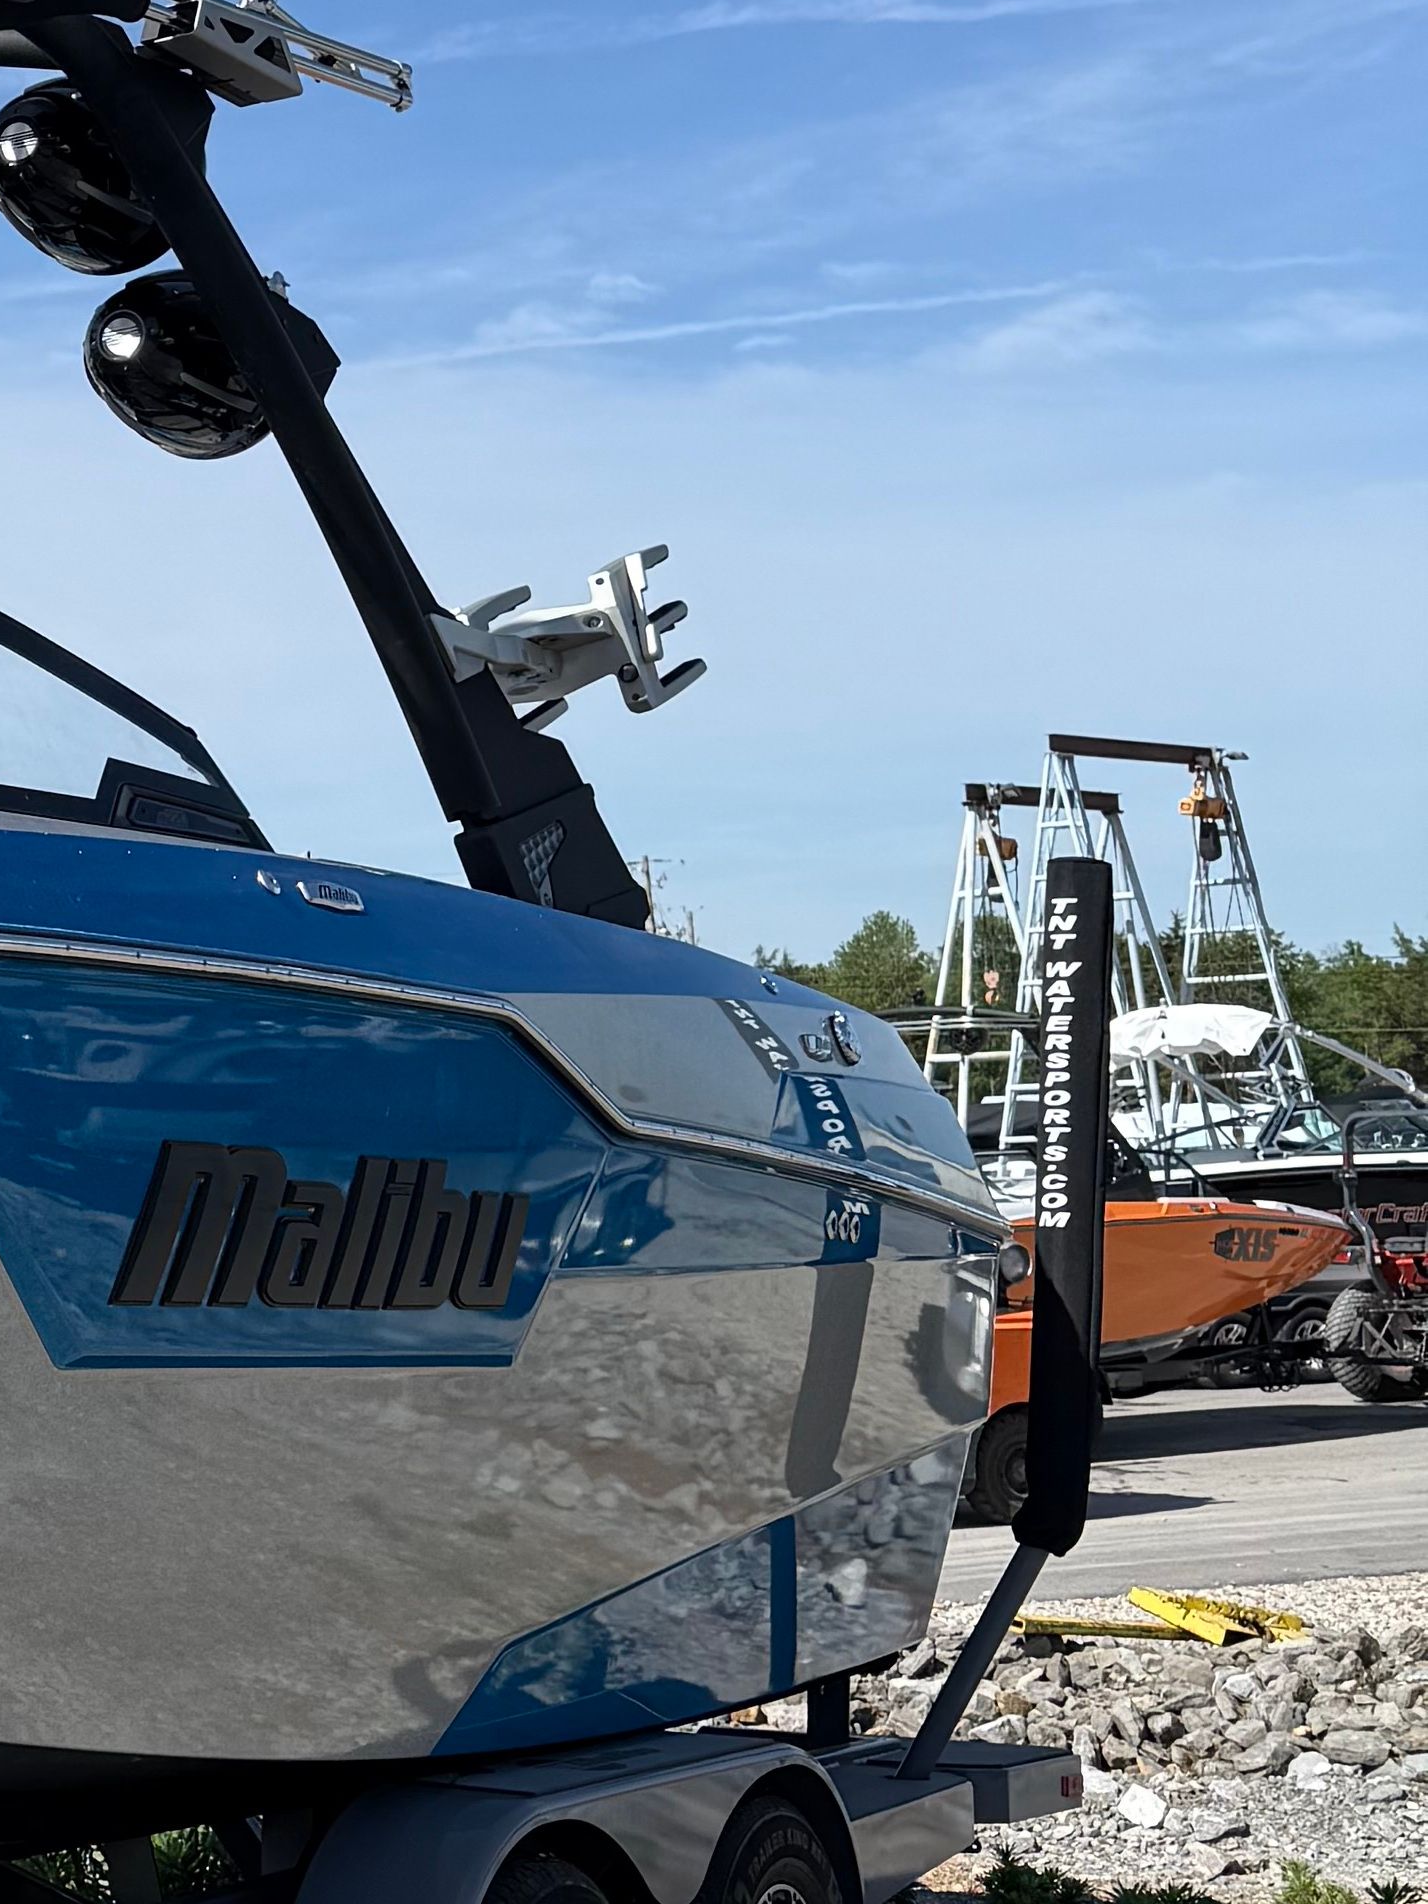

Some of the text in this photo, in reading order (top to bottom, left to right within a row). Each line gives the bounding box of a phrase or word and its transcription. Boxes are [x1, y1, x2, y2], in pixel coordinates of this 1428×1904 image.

[1038, 897, 1083, 1229] TNT WATERSPORTS.COM
[107, 1139, 530, 1311] Malibu
